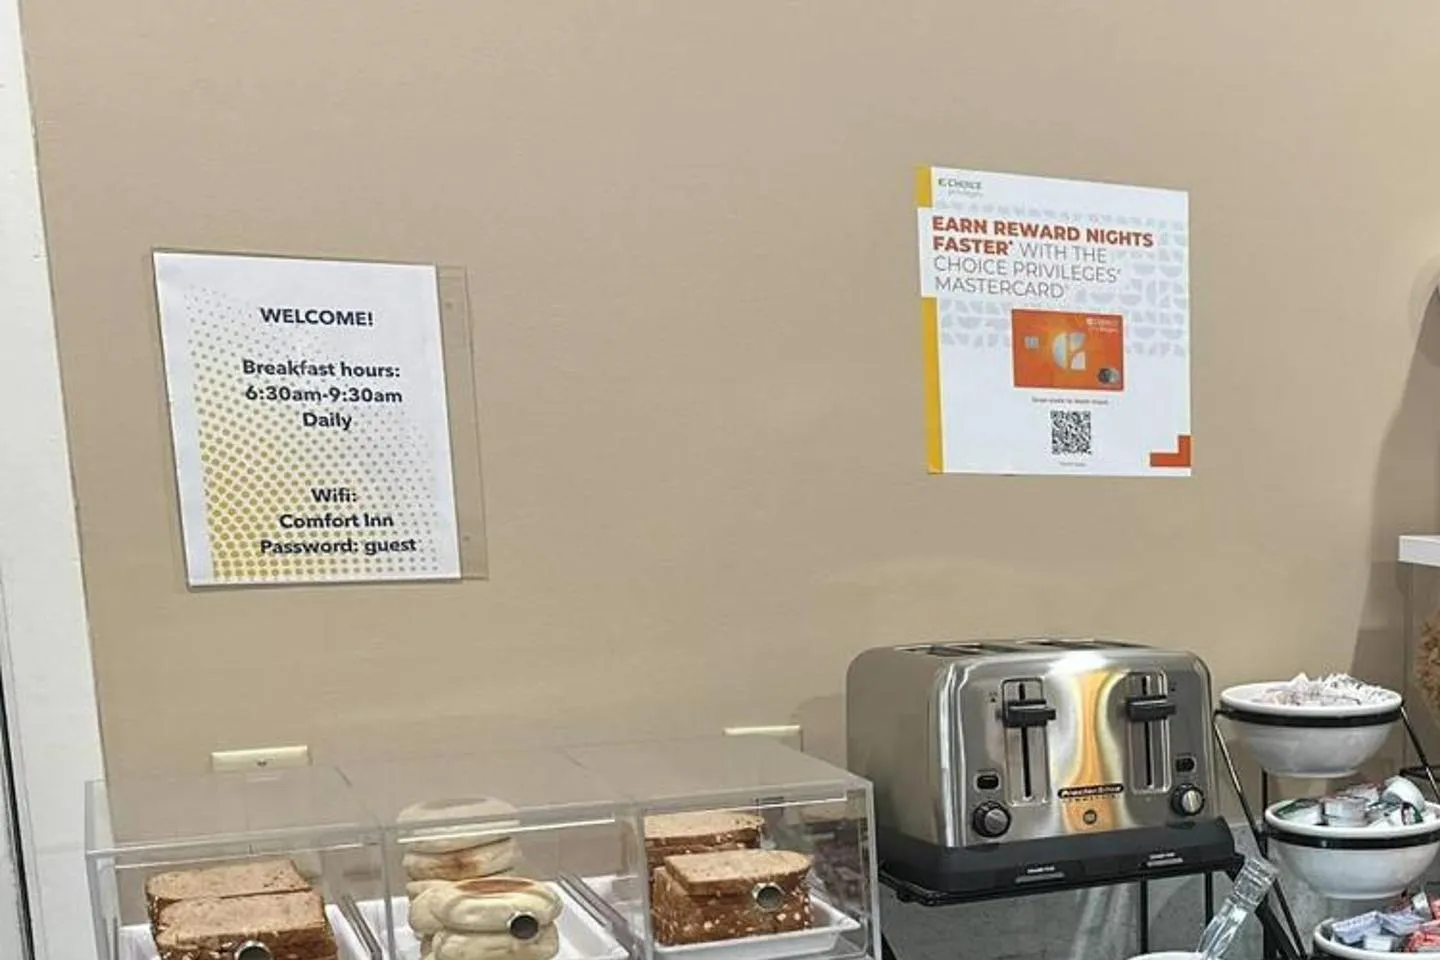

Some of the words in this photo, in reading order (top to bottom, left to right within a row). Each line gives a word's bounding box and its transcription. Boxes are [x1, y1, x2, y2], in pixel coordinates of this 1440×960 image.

[932, 216, 987, 234] EARN
[994, 220, 1080, 241] REWARD
[1086, 228, 1153, 247] NIGHTS
[1020, 243, 1066, 260] WITH
[1072, 246, 1106, 263] THE
[934, 255, 1008, 275] CHOICE
[260, 307, 374, 326] WELCOME!
[242, 359, 335, 376] Breakfast
[340, 362, 400, 378] hours:
[245, 387, 403, 403] 6:30am-9:30am
[303, 413, 352, 431] Daily
[311, 488, 357, 503] Wifi:
[279, 514, 360, 529] Comfort
[364, 514, 394, 528] Inn
[260, 538, 359, 554] Password:
[364, 539, 417, 555] guest
